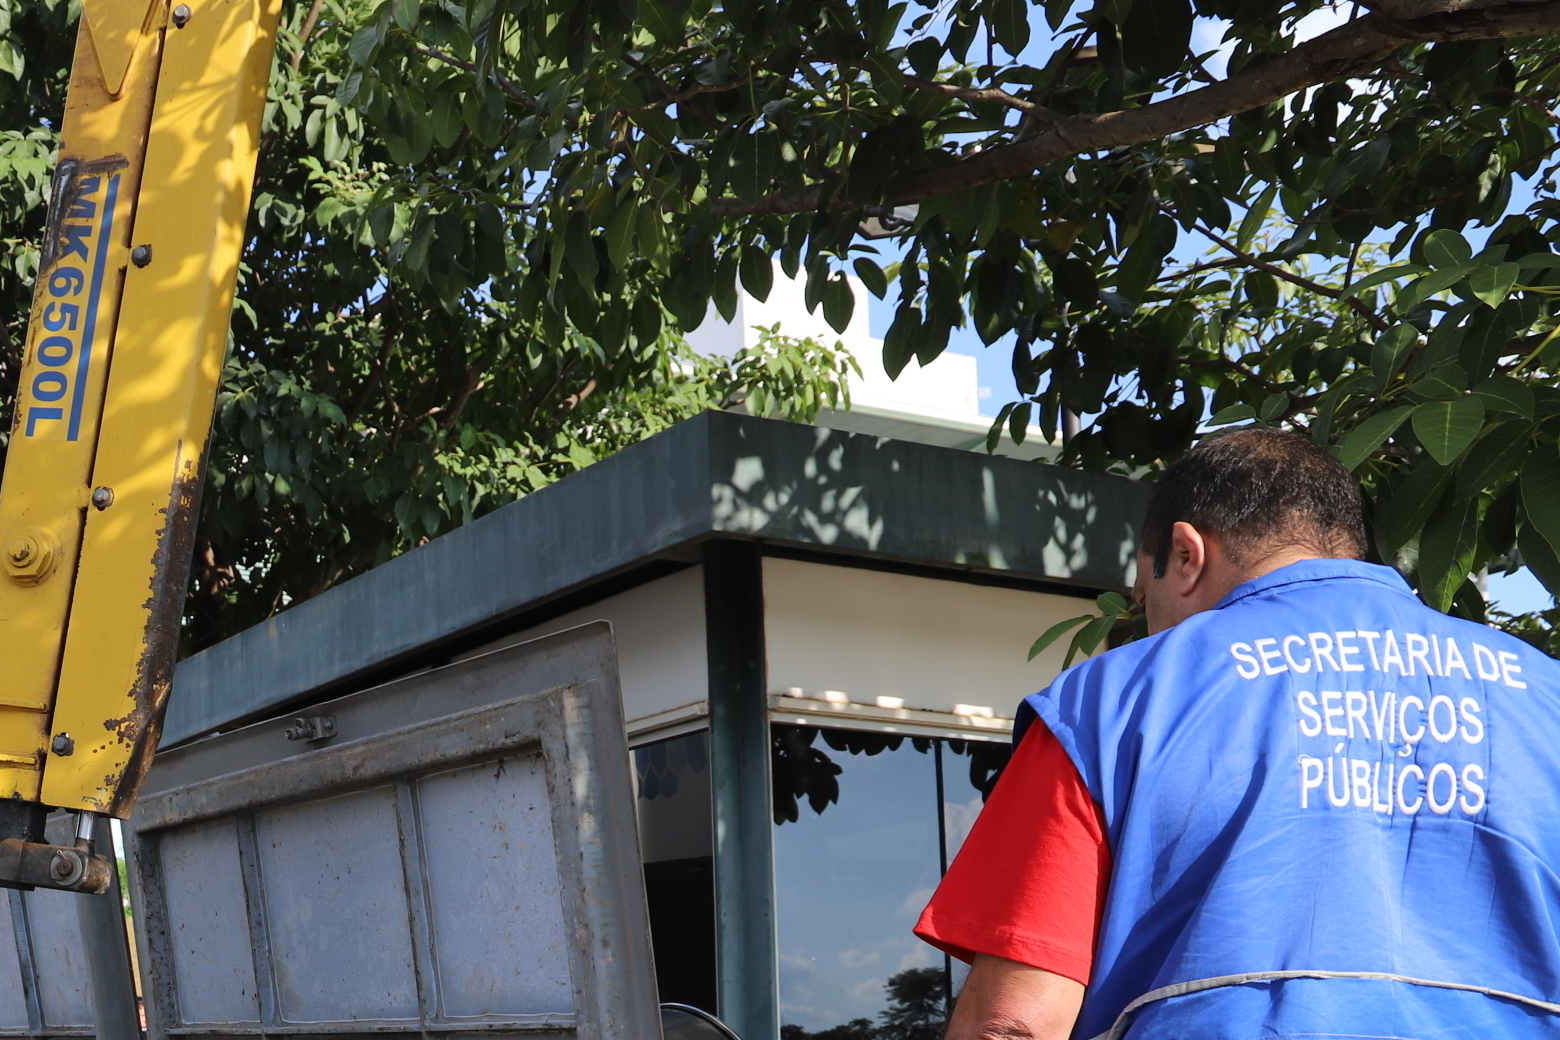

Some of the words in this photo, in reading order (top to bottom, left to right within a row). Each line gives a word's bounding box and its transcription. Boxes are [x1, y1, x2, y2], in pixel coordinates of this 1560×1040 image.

[25, 176, 101, 438] MK6500L
[1230, 629, 1472, 680] SECRETARIA
[1472, 642, 1527, 689] DE
[1297, 690, 1484, 757] SERVIÇOS
[1300, 742, 1485, 815] PÚBLICOS
